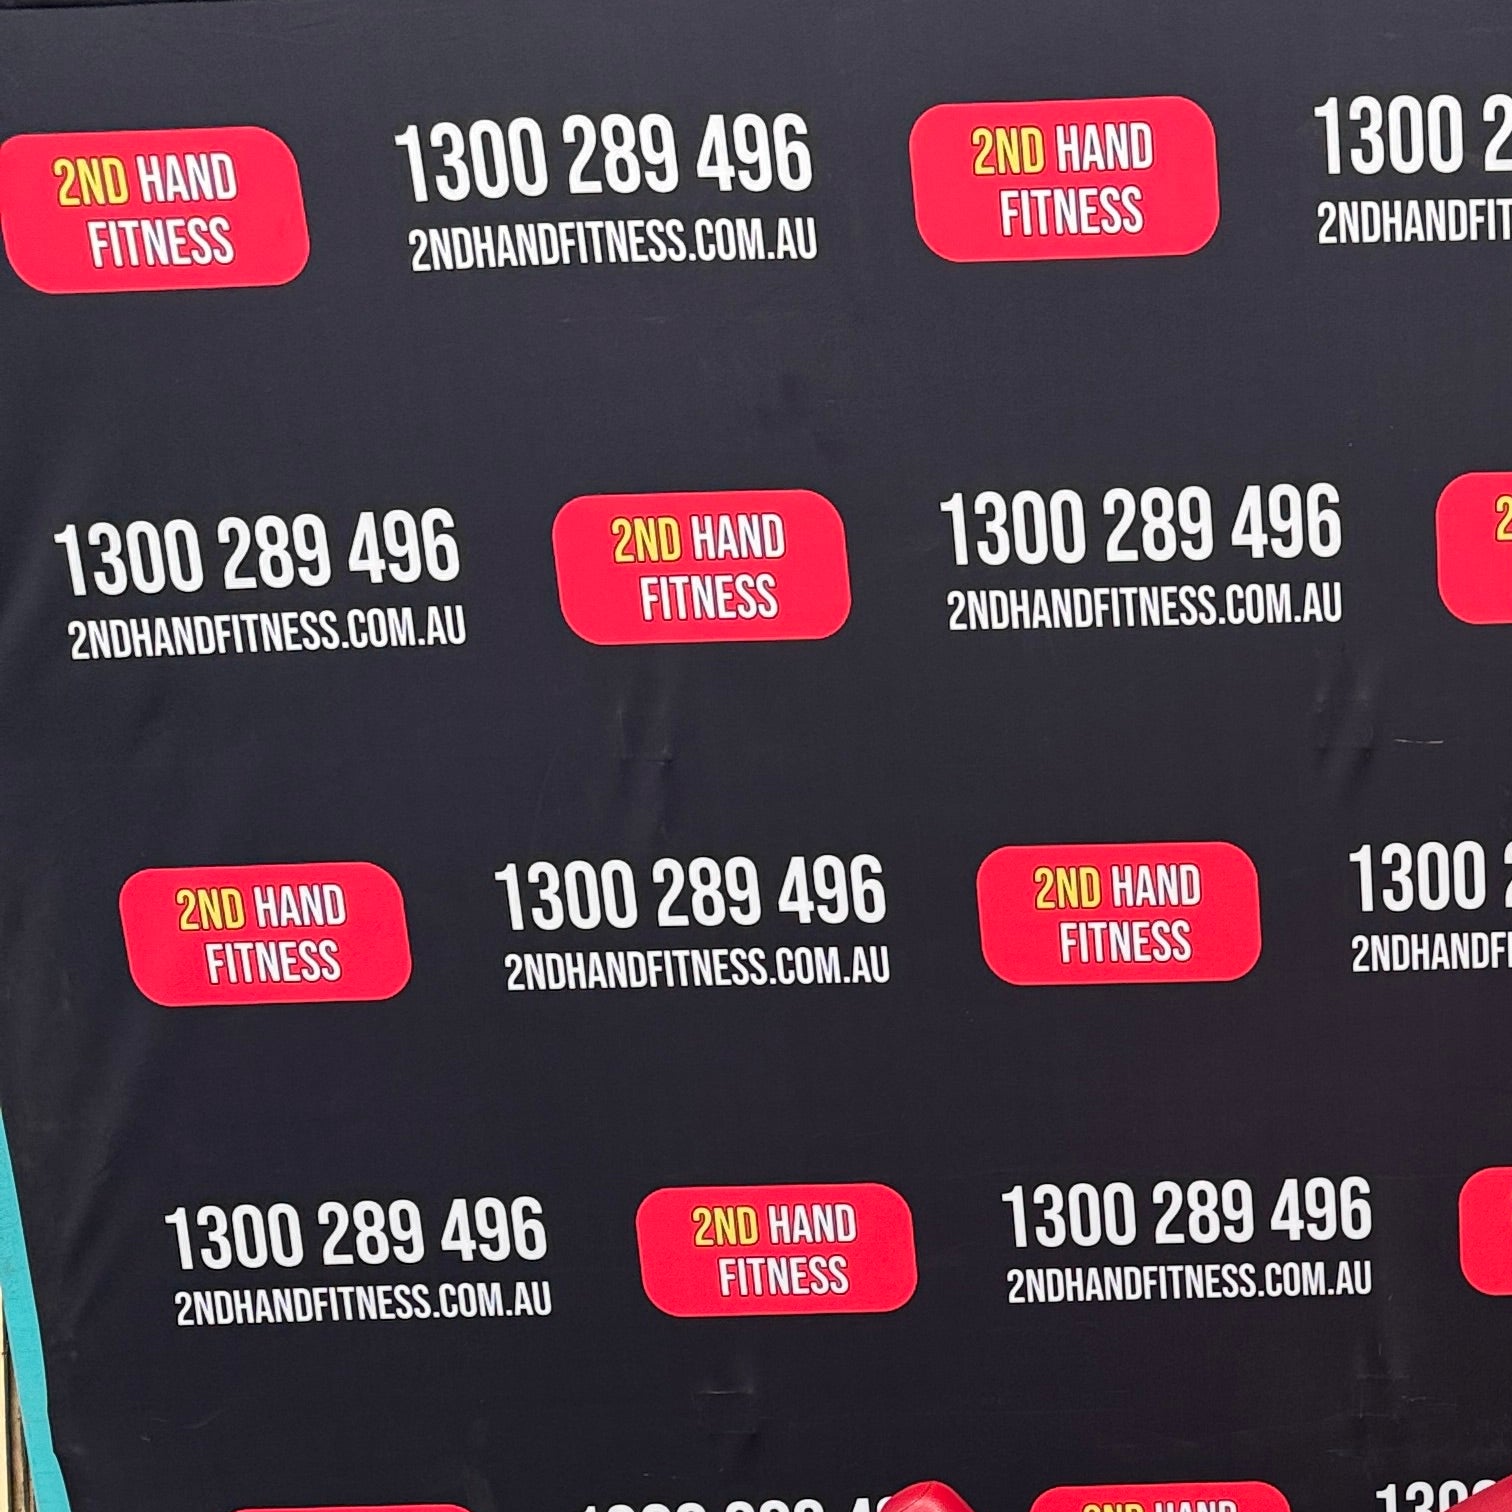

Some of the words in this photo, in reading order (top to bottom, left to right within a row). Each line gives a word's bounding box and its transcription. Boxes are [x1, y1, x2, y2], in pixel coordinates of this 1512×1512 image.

[394, 116, 549, 203] 1300
[562, 113, 679, 194] 289
[696, 112, 813, 193] 496
[972, 127, 1045, 175] 2ND
[1055, 122, 1153, 172] HAND
[1313, 94, 1464, 175] 1300
[53, 157, 129, 206] 2ND
[136, 152, 237, 203] HAND
[1000, 185, 1144, 236] FITNESS
[87, 216, 234, 268] FITNESS
[408, 216, 818, 272] 2NDHANDFITNESS.COM.AU
[611, 517, 681, 563] 2ND
[691, 513, 785, 560] HAND
[939, 488, 1086, 566] 1300
[1102, 485, 1214, 563] 289
[1231, 482, 1342, 559] 496
[53, 518, 204, 597] 1300
[217, 513, 332, 590] 289
[348, 507, 460, 584] 496
[640, 573, 778, 621] FITNESS
[946, 581, 1342, 631] 2NDHANDFITNESS.COM.AU
[67, 604, 467, 660] 2NDHANDFITNESS.COM.AU
[494, 859, 638, 931] 1300
[652, 856, 762, 927] 289
[777, 853, 887, 925] 496
[1034, 866, 1101, 909] 2ND
[1111, 864, 1201, 907] HAND
[1348, 840, 1486, 912] 1300
[176, 888, 245, 931] 2ND
[253, 884, 346, 928] HAND
[205, 939, 341, 984] FITNESS
[1060, 919, 1192, 963] FITNESS
[504, 945, 890, 991] 2NDHANDFITNESS.COM.AU
[164, 1202, 304, 1270] 1300
[317, 1199, 425, 1266] 289
[440, 1195, 547, 1262] 496
[692, 1206, 759, 1246] 2ND
[768, 1203, 857, 1244] HAND
[1001, 1181, 1137, 1248] 1300
[1152, 1179, 1255, 1245] 289
[1270, 1175, 1372, 1241] 496
[718, 1255, 849, 1296] FITNESS
[1006, 1260, 1372, 1304] 2NDHANDFITNESS.COM.AU
[174, 1280, 552, 1326] 2NDHANDFITNESS.COM.AU
